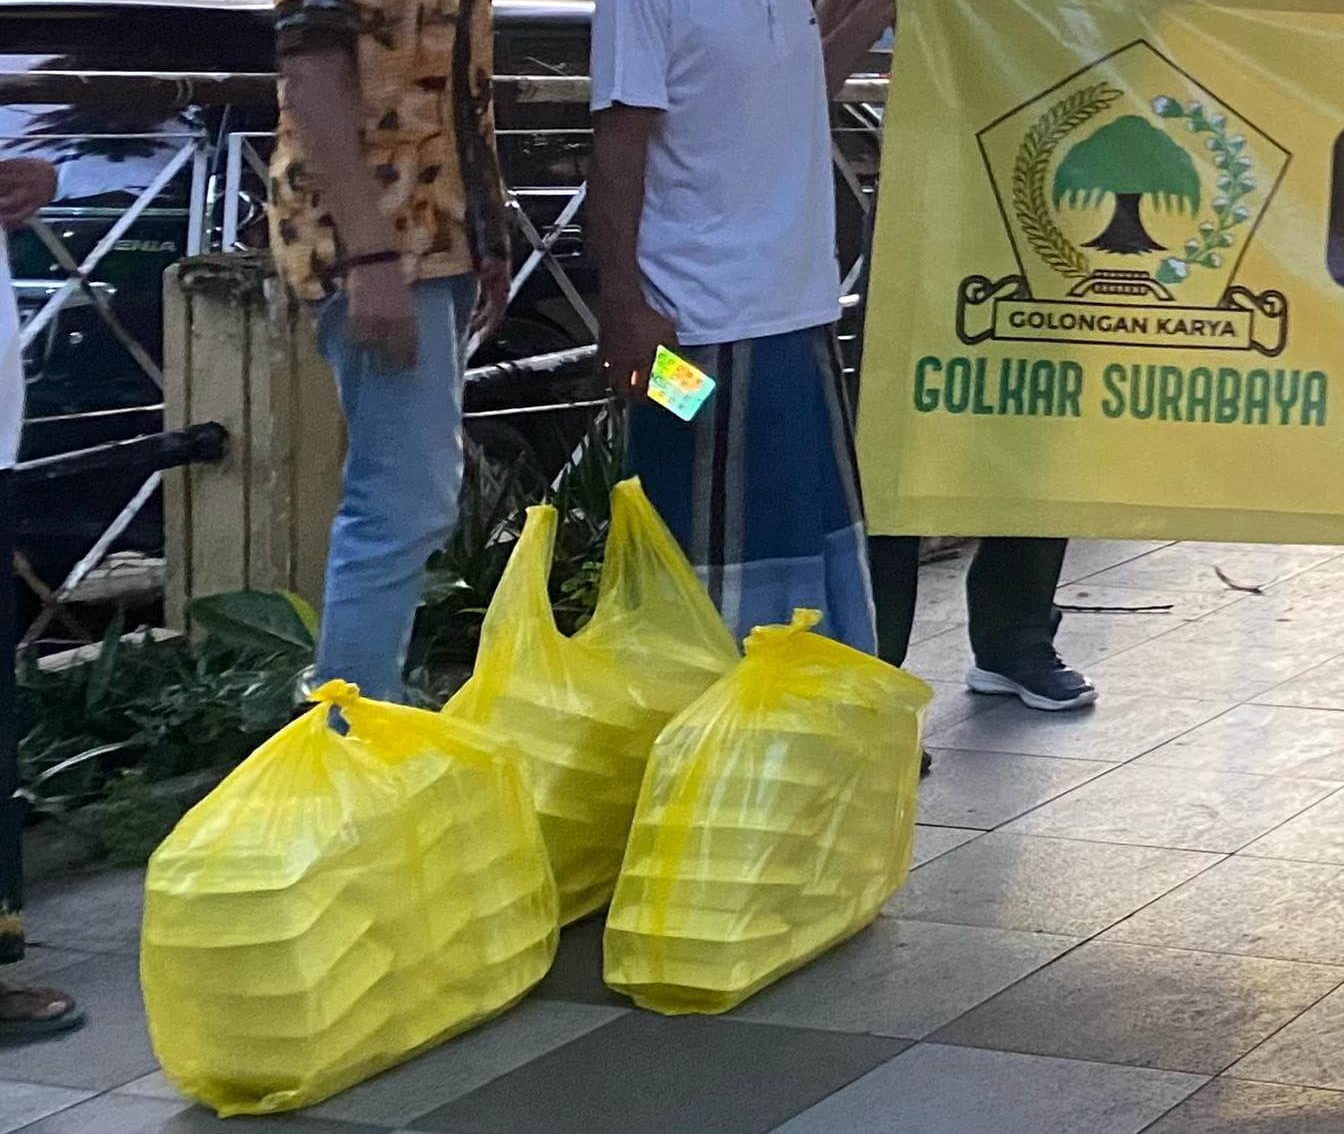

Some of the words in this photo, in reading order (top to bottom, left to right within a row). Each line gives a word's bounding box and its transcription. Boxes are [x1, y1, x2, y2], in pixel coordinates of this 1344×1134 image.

[1009, 310, 1147, 334] GOLONGAN
[1155, 314, 1236, 338] KARYA
[914, 356, 1081, 417] GOLKAR
[1103, 363, 1328, 427] SURABAYA
